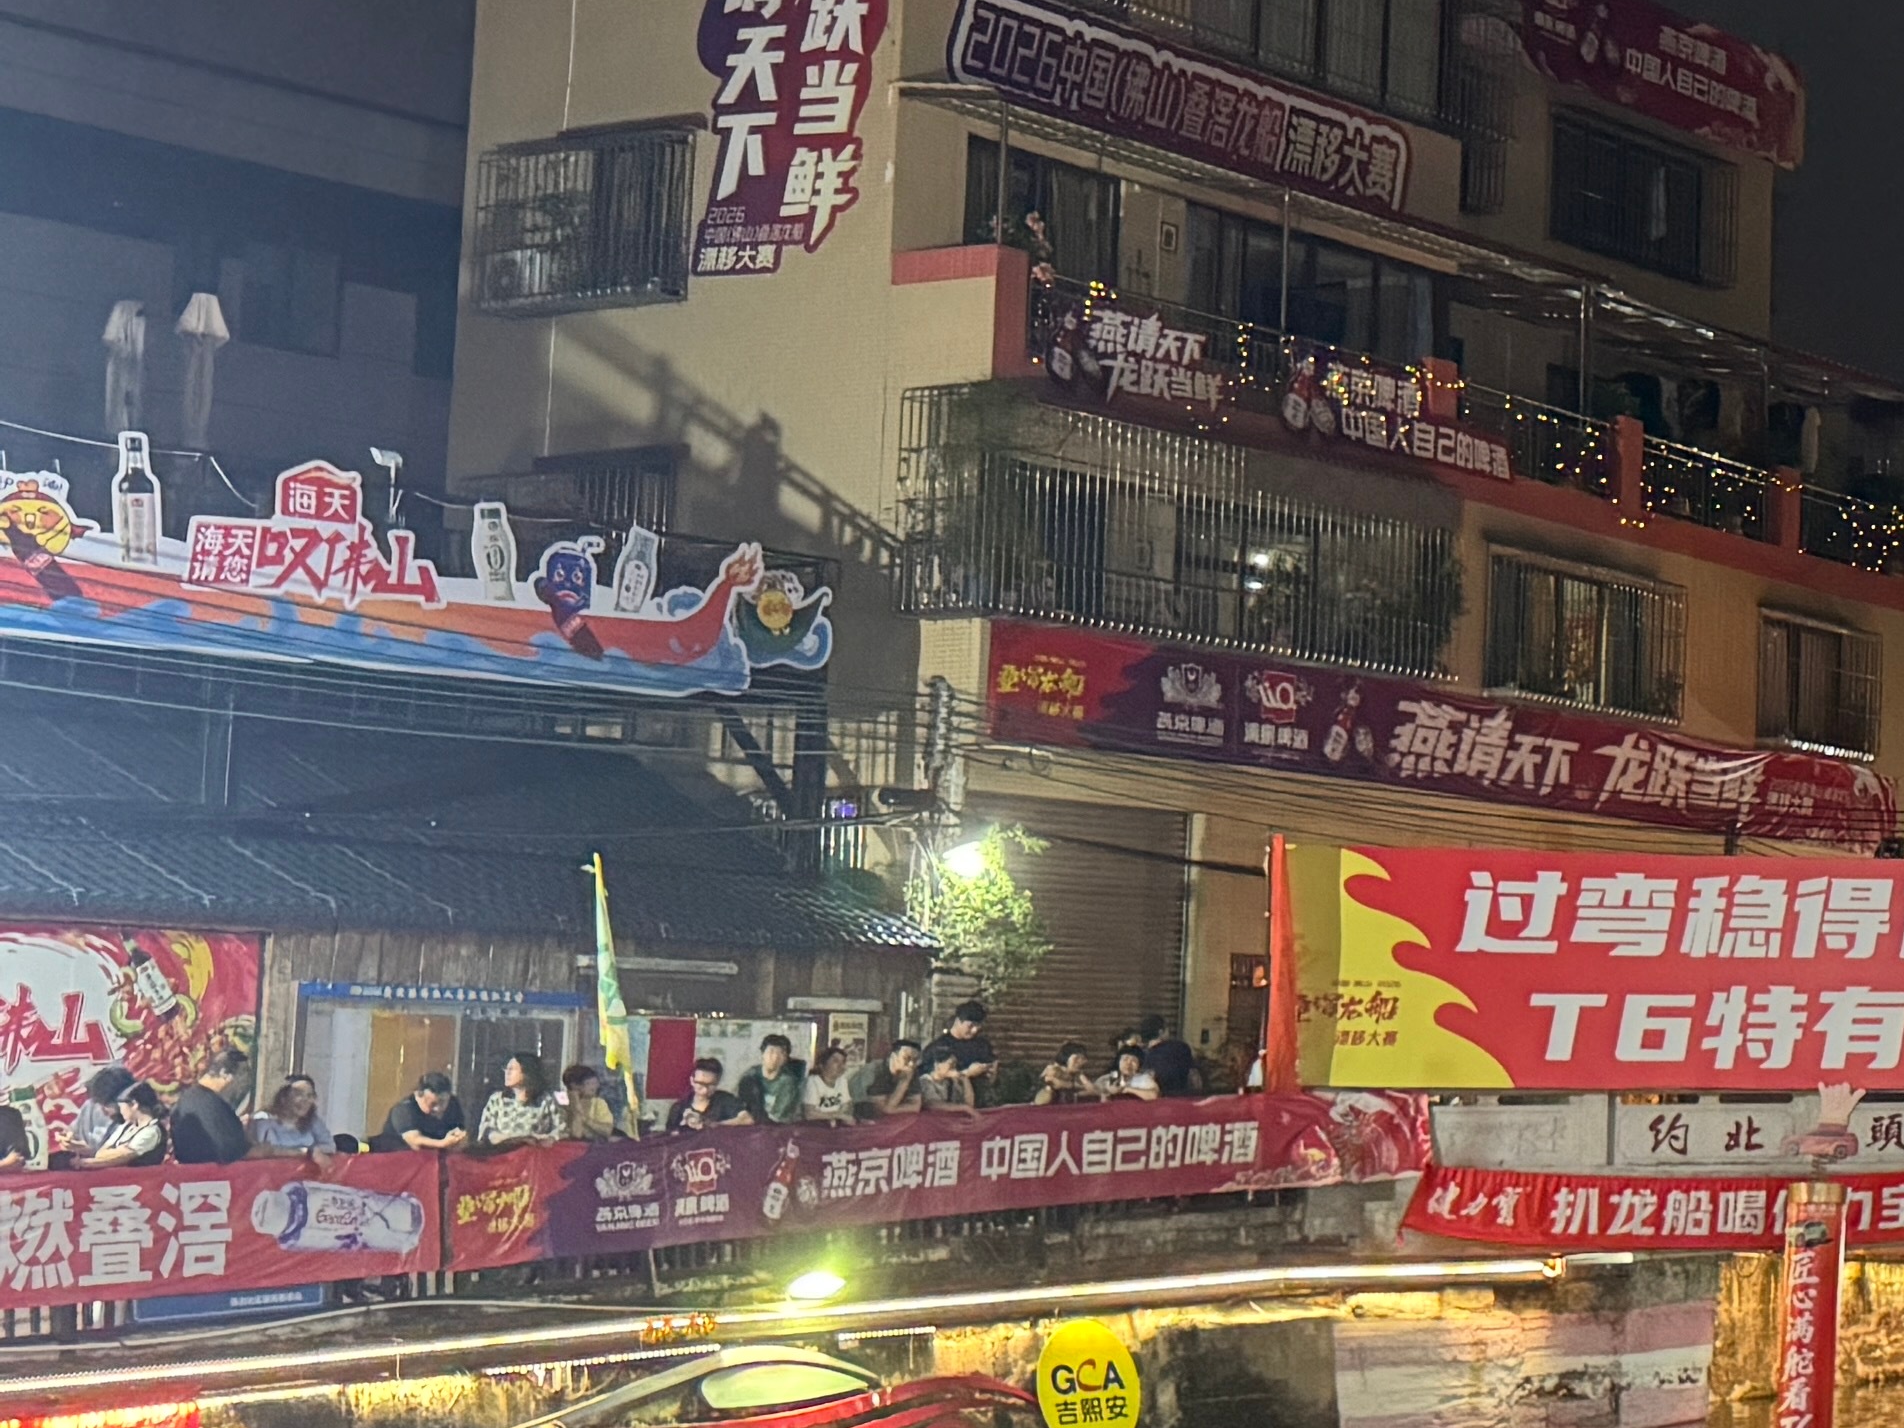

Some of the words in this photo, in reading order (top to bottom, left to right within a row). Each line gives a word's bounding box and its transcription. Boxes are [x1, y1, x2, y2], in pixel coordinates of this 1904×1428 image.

[707, 206, 745, 224] 2026
[698, 244, 776, 272] 漂移大赛
[1089, 308, 1206, 366] 燕请天下
[1341, 406, 1511, 480] 中国人自己的啤酒
[289, 482, 350, 519] 海天
[196, 525, 253, 556] 海天
[1384, 699, 1580, 796] 燕请天下
[821, 1141, 961, 1197] 燕京啤酒
[980, 1122, 1259, 1181] 中国人自己的啤酒
[1051, 1359, 1125, 1395] GCA
